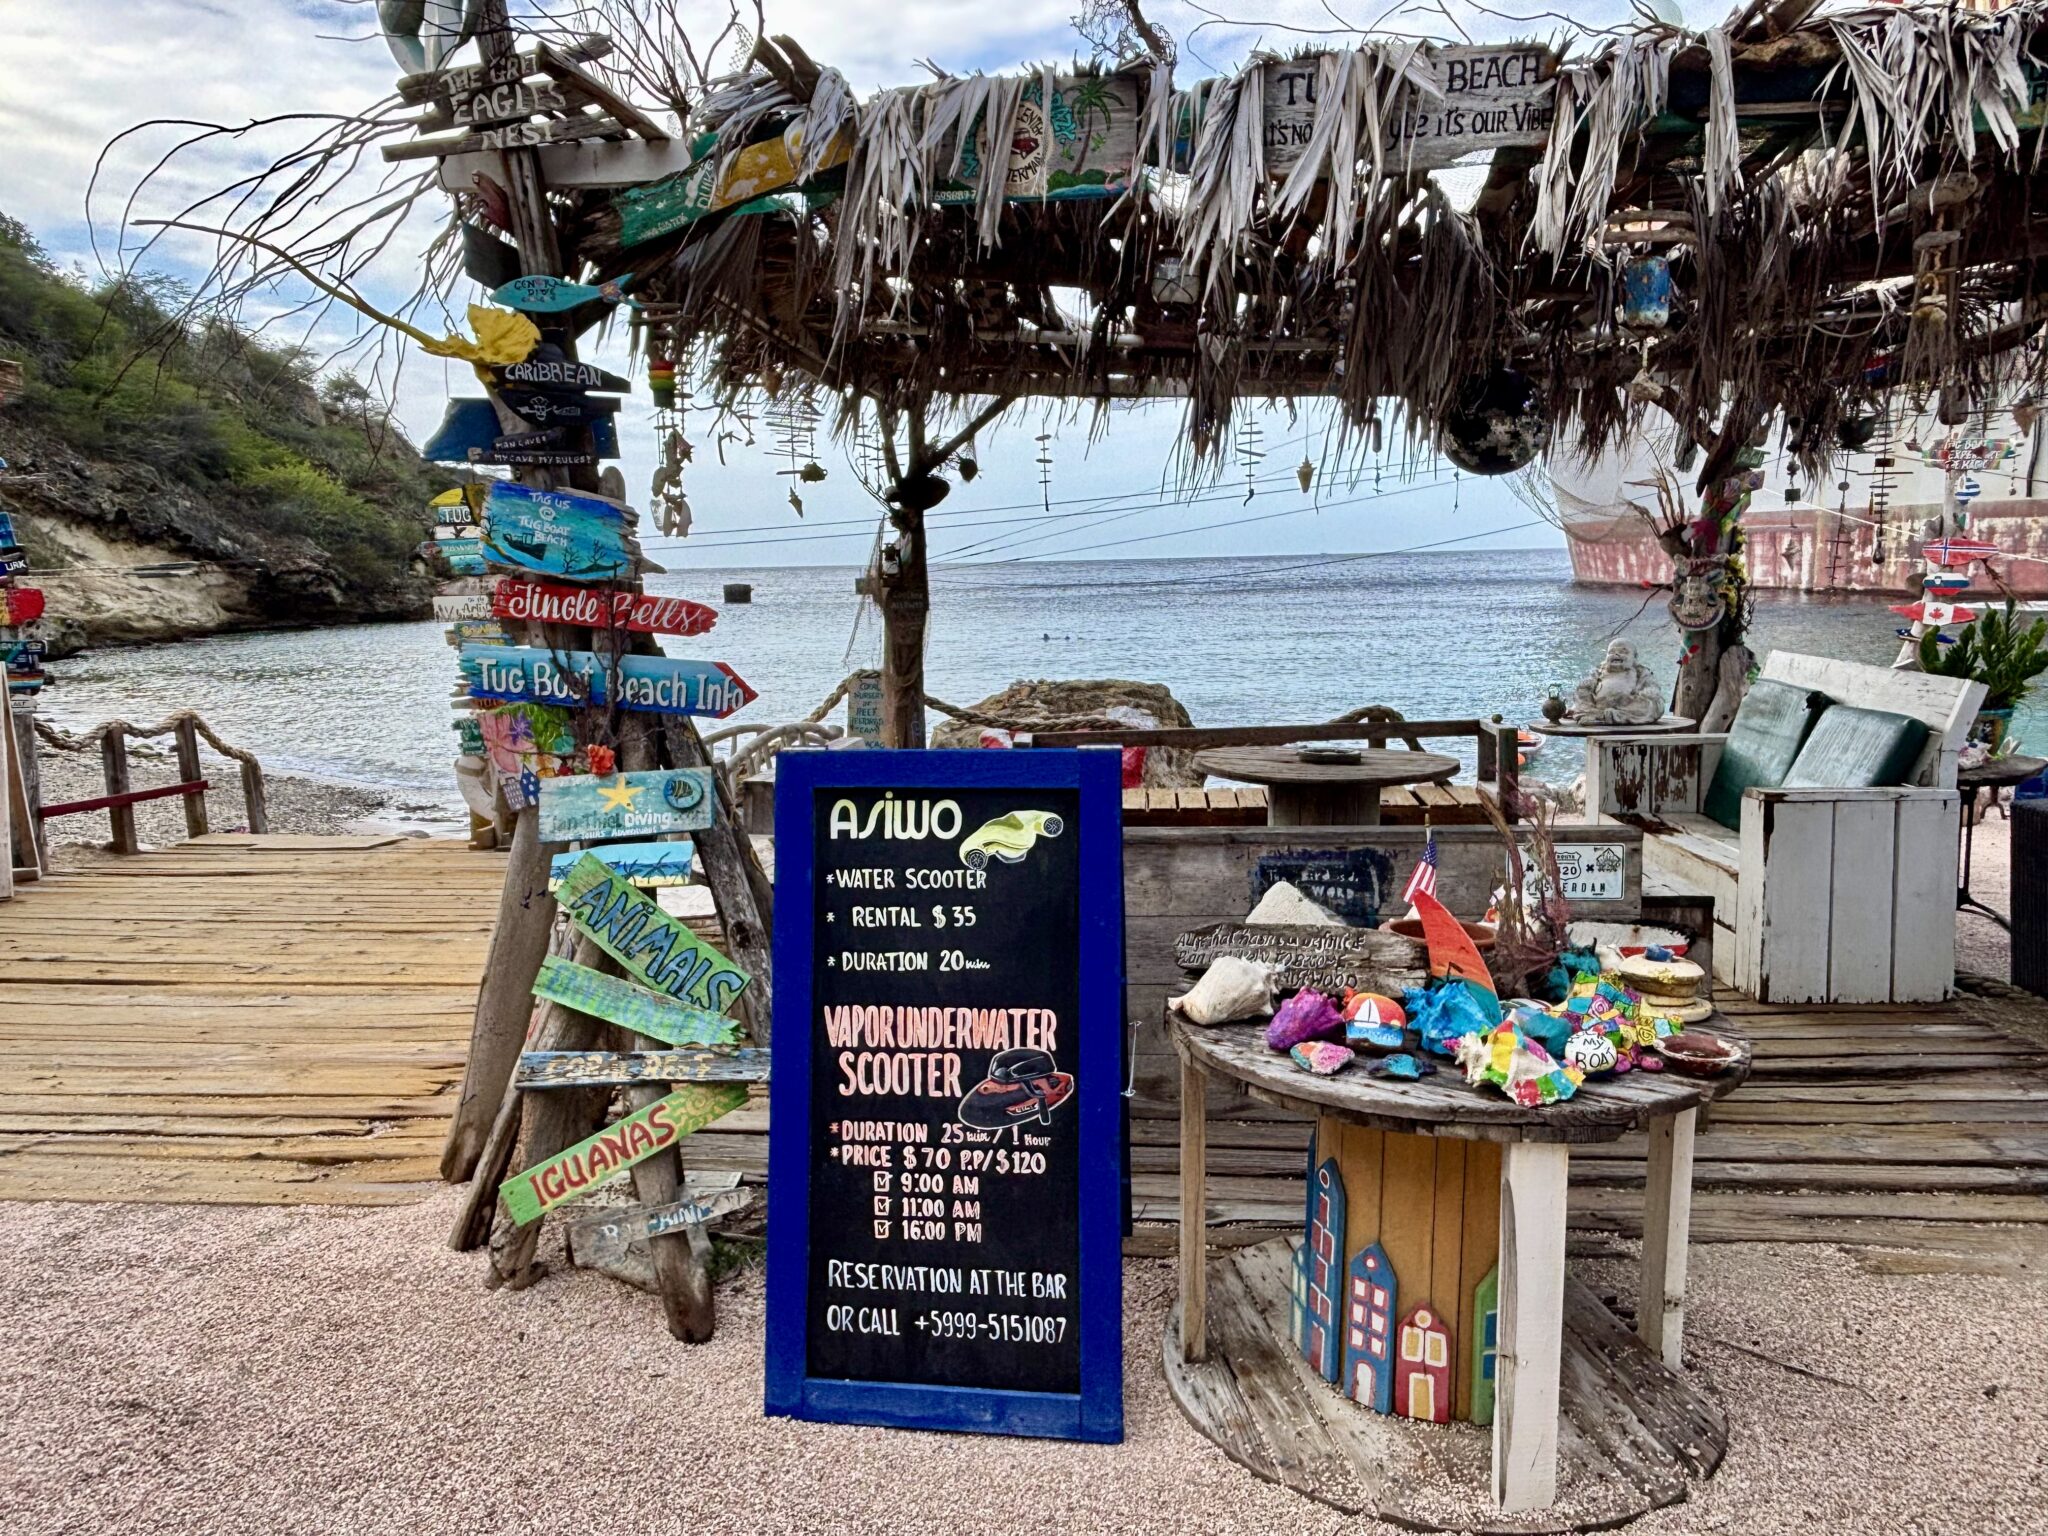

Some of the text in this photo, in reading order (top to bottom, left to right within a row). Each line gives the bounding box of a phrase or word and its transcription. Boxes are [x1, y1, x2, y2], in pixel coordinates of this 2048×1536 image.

[439, 67, 482, 95] THE
[1448, 54, 1542, 93] BEACH
[450, 82, 566, 125] EAGLES
[481, 119, 556, 150] NEST
[1471, 110, 1508, 137] OUR
[529, 491, 571, 510] TAG US
[539, 505, 556, 521] @
[518, 515, 570, 536] TUG BOAT
[534, 530, 568, 548] BEACH
[508, 583, 600, 624] Jingle
[613, 592, 702, 633] Bells
[695, 673, 745, 711] Info
[835, 868, 987, 890] WATER SCOOTER
[1558, 866, 1578, 876] 20
[1311, 885, 1355, 900] WORD
[852, 906, 921, 928] RENTAL
[842, 951, 928, 971] DURATION
[1575, 1046, 1616, 1071] BOAT
[838, 1051, 962, 1098] SCOOTER
[841, 1120, 928, 1143] DURATION
[528, 1103, 677, 1208] IGUANAS
[842, 1146, 893, 1168] PRICE
[900, 1173, 979, 1196] 9:00 AM
[901, 1197, 981, 1220] 11:00 AM
[901, 1220, 982, 1244] 16:00 PM
[828, 1258, 962, 1294] RESERVATION
[991, 1269, 1027, 1298] THE
[1031, 1272, 1067, 1300] BAR
[826, 1304, 1067, 1344] OR CALL +5999-5151087
